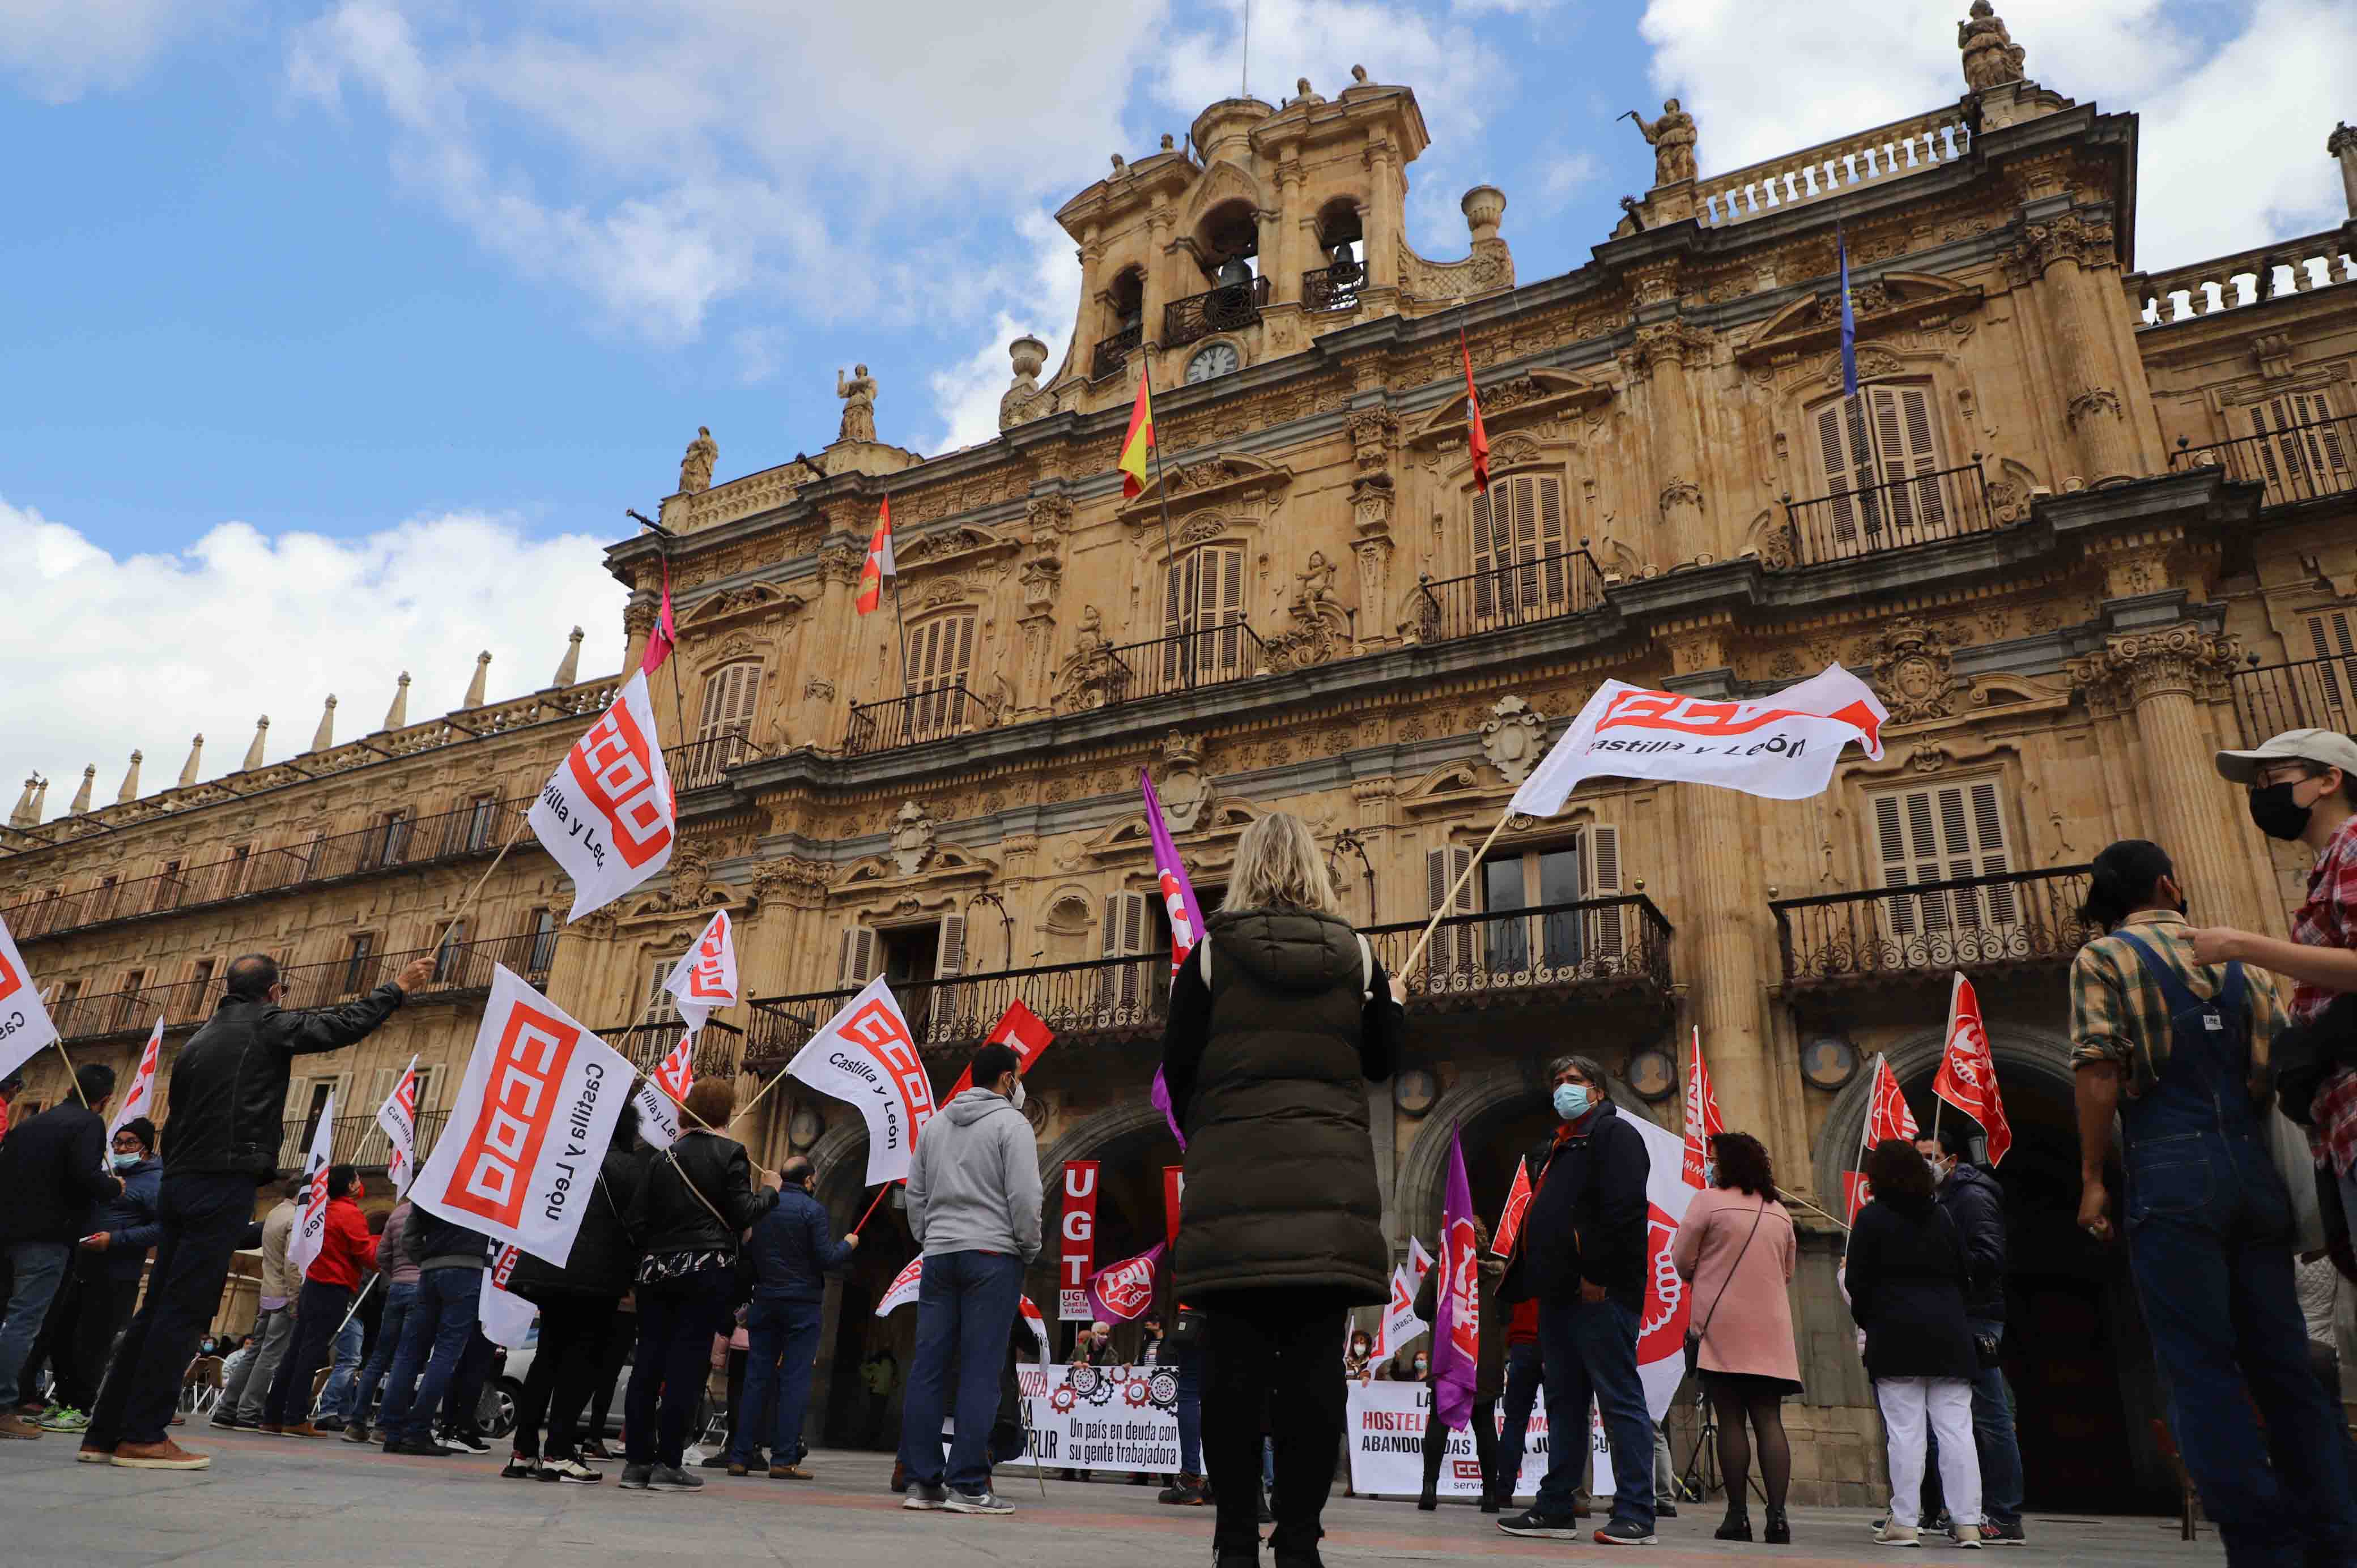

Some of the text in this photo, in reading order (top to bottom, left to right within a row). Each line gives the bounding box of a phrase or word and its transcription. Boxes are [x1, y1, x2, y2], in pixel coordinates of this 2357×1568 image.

[1591, 740, 1686, 753] astilla
[1722, 734, 1806, 759] León
[569, 817, 583, 836] y
[829, 1053, 899, 1150] Castilla y León
[387, 1106, 412, 1144] Castilla
[653, 1111, 664, 1123] y
[1062, 1169, 1095, 1285] UGT
[1070, 1418, 1177, 1443] Un país en deuda con
[1069, 1442, 1176, 1467] su gente trabajadora
